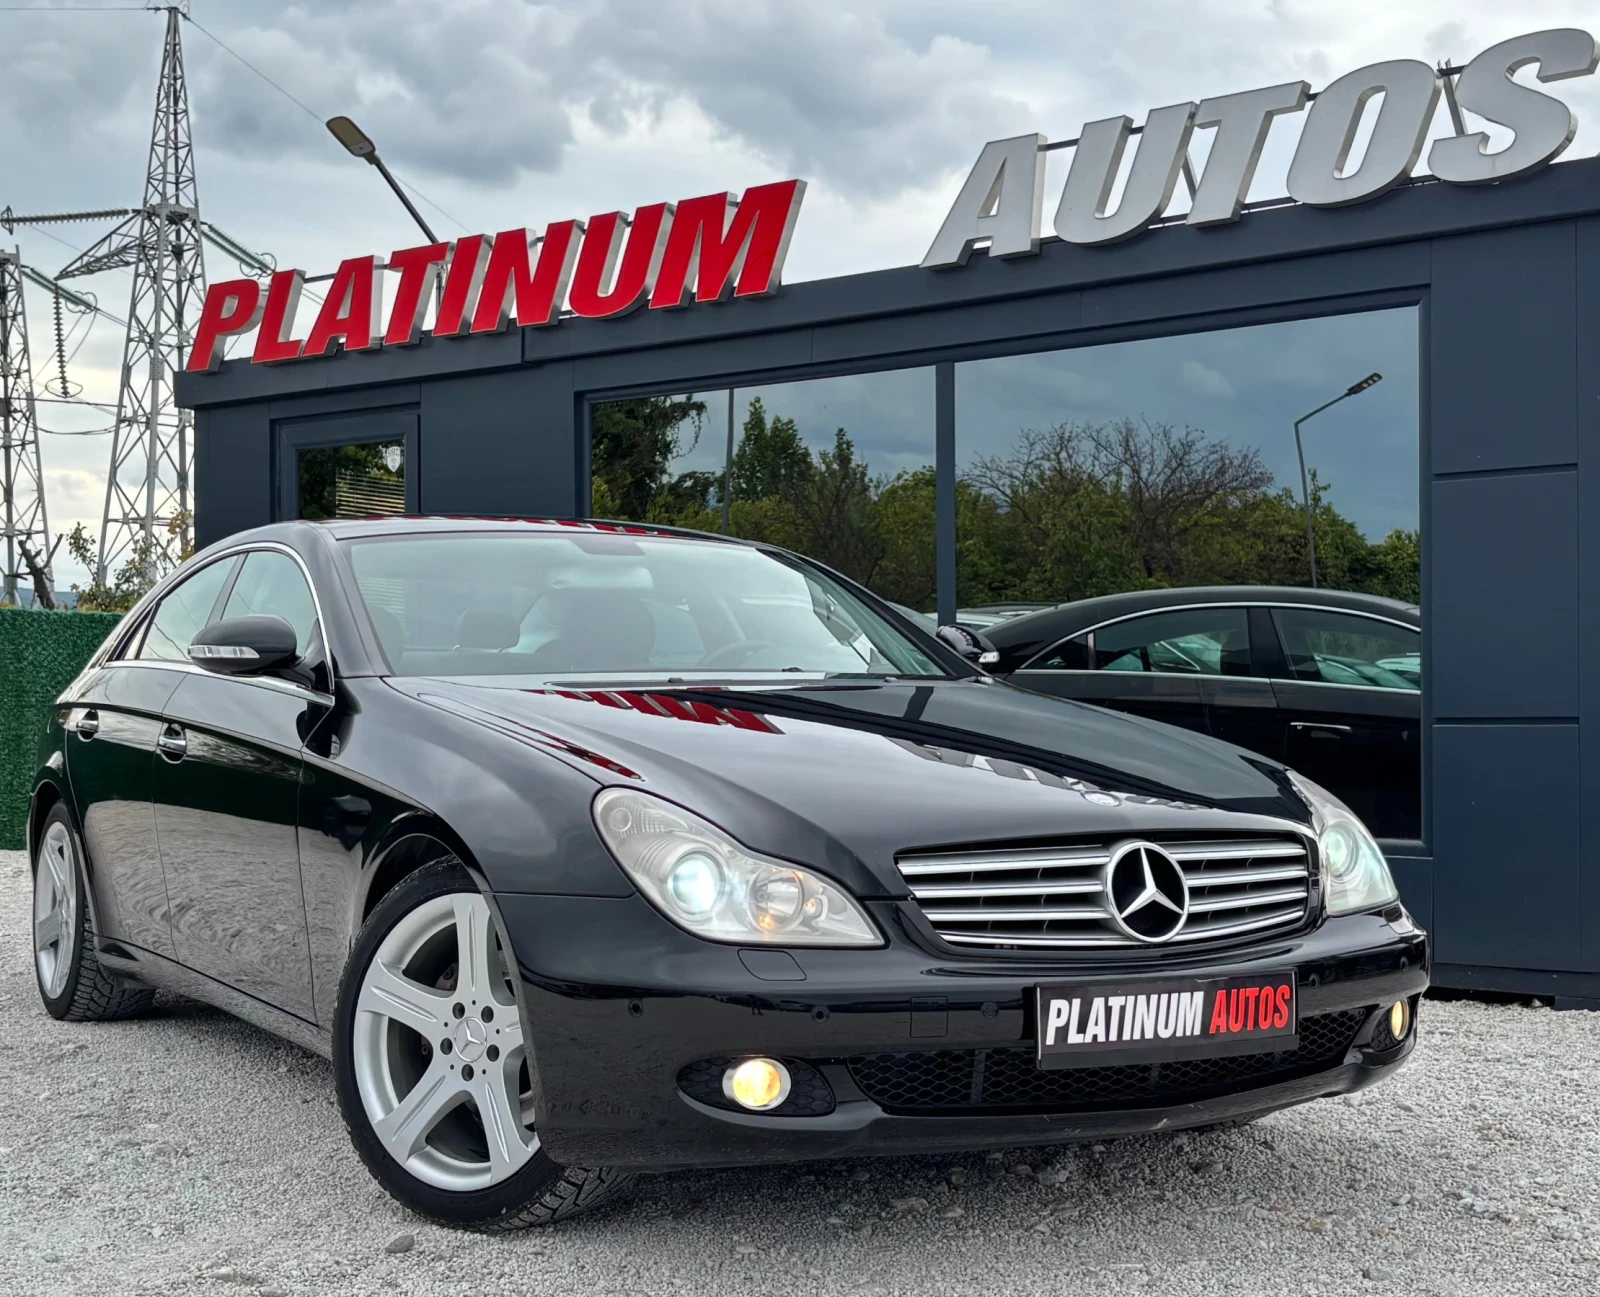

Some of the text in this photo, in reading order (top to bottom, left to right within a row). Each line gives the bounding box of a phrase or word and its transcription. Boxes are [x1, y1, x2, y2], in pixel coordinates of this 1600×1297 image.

[187, 28, 1600, 373] PLATINUM AUTOS
[1045, 984, 1291, 1046] PLATINUM AUTOS
